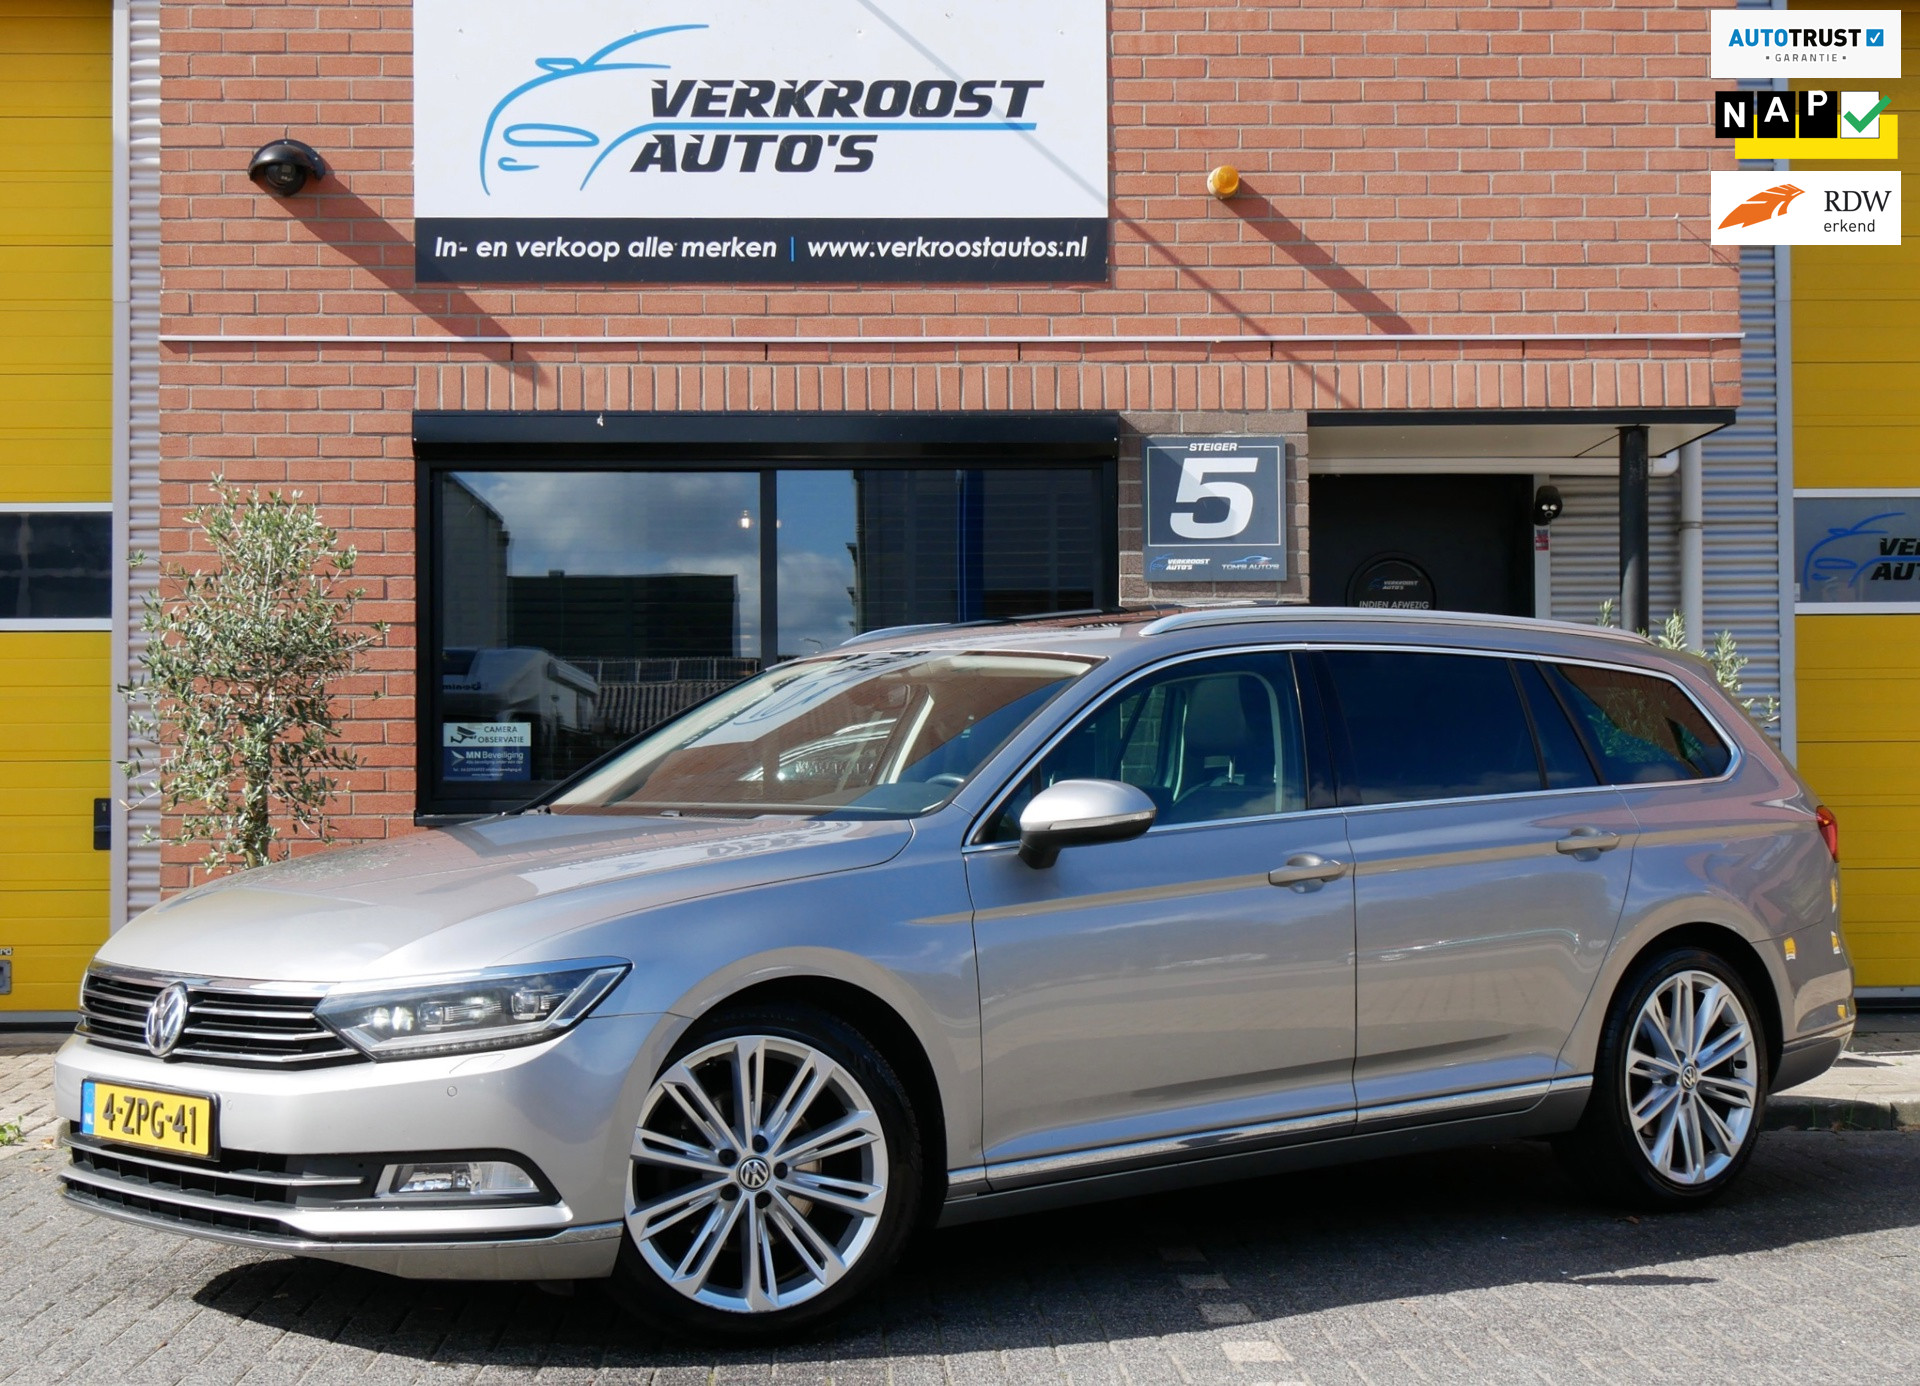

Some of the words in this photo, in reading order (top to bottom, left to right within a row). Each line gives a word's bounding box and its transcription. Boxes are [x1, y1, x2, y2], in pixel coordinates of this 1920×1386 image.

[650, 79, 1044, 118] VERKROOST
[630, 134, 878, 173] AUTO'S
[435, 236, 468, 258] In-
[475, 240, 508, 258] en
[514, 236, 621, 264] verkoop
[626, 235, 674, 258] alle
[680, 235, 777, 258] merken
[806, 235, 1089, 258] www.verkroostautos.nl
[1189, 442, 1238, 452] STEIGER
[1169, 457, 1259, 539] 5
[1880, 537, 1920, 556] VE
[1870, 562, 1920, 581] AU
[1359, 600, 1389, 609] INDIEN
[1391, 600, 1430, 609] AFWEZIG
[483, 725, 518, 733] CAMERA
[477, 735, 525, 744] OBSERVATIE
[466, 751, 482, 759] MN
[482, 750, 524, 761] Beveiliging
[102, 1092, 196, 1145] 4-ZPG-41
